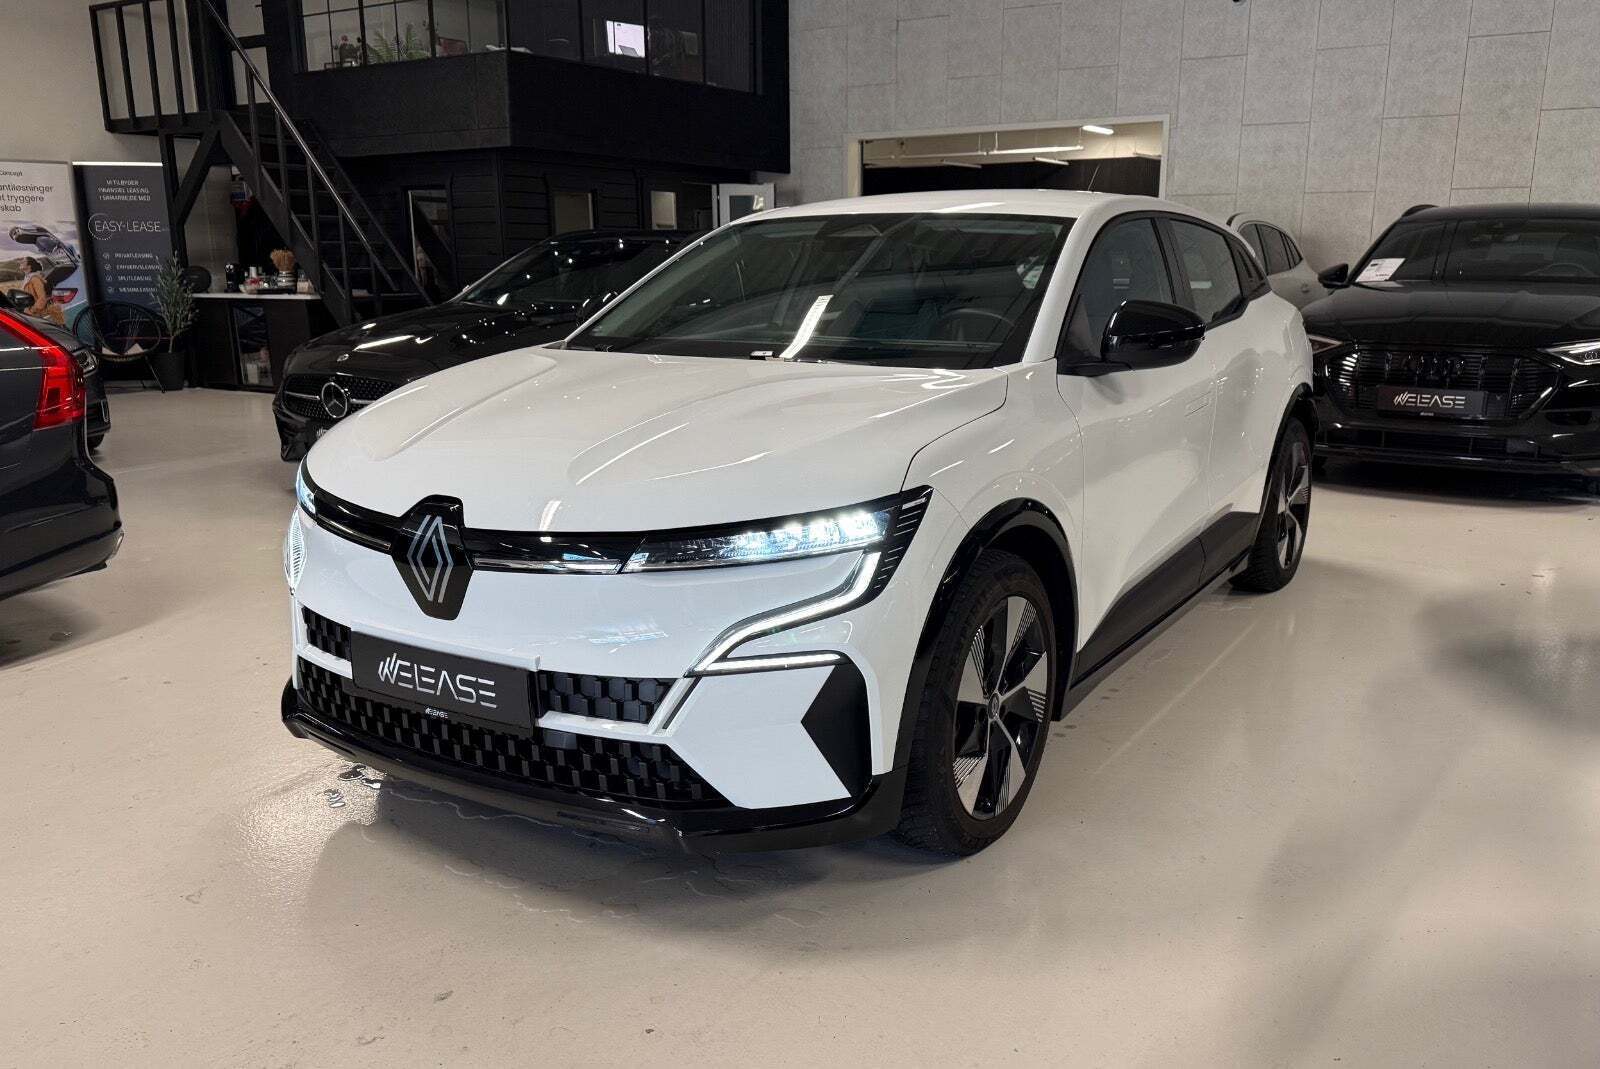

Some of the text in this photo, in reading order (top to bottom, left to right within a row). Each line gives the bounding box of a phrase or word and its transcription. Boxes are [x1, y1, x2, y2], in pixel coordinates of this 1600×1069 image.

[7, 194, 45, 204] tryggere
[1394, 391, 1466, 409] WELEASE
[378, 652, 498, 709] WELEASE
